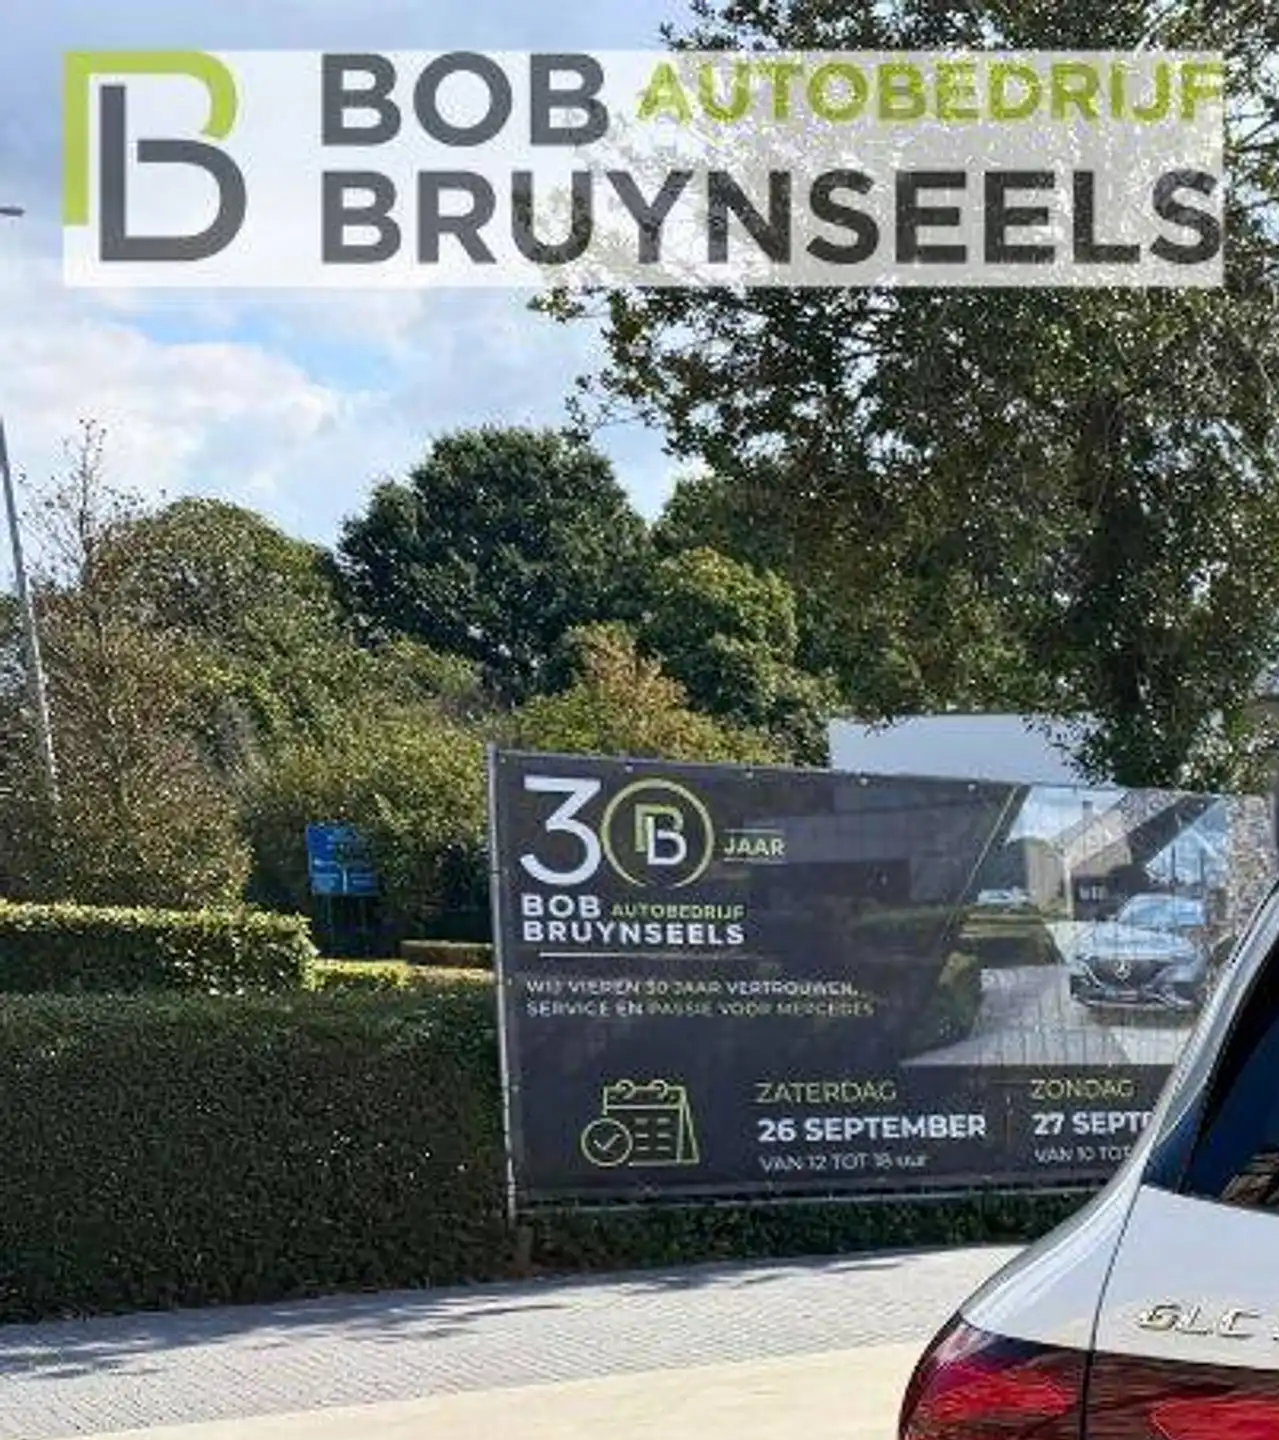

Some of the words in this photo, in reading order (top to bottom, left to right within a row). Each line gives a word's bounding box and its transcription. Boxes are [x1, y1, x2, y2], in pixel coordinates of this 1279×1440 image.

[723, 839, 786, 857] JAAR
[521, 893, 601, 918] BOB
[611, 903, 745, 919] AUTOBEDRIJF
[523, 920, 745, 944] BRUYNSEELS
[526, 1000, 611, 1017] SERVICE
[615, 1001, 644, 1017] EN
[755, 1080, 897, 1104] ZATERDAG
[1030, 1079, 1134, 1100] ZONDAG
[757, 1117, 797, 1142] 26
[804, 1113, 988, 1142] SEPTEMBER
[1032, 1111, 1066, 1136] 27
[757, 1155, 802, 1172] VAN
[807, 1156, 828, 1171] 12
[832, 1152, 869, 1170] TOT
[1034, 1148, 1072, 1163] VAN
[1138, 1303, 1262, 1338] GLC
